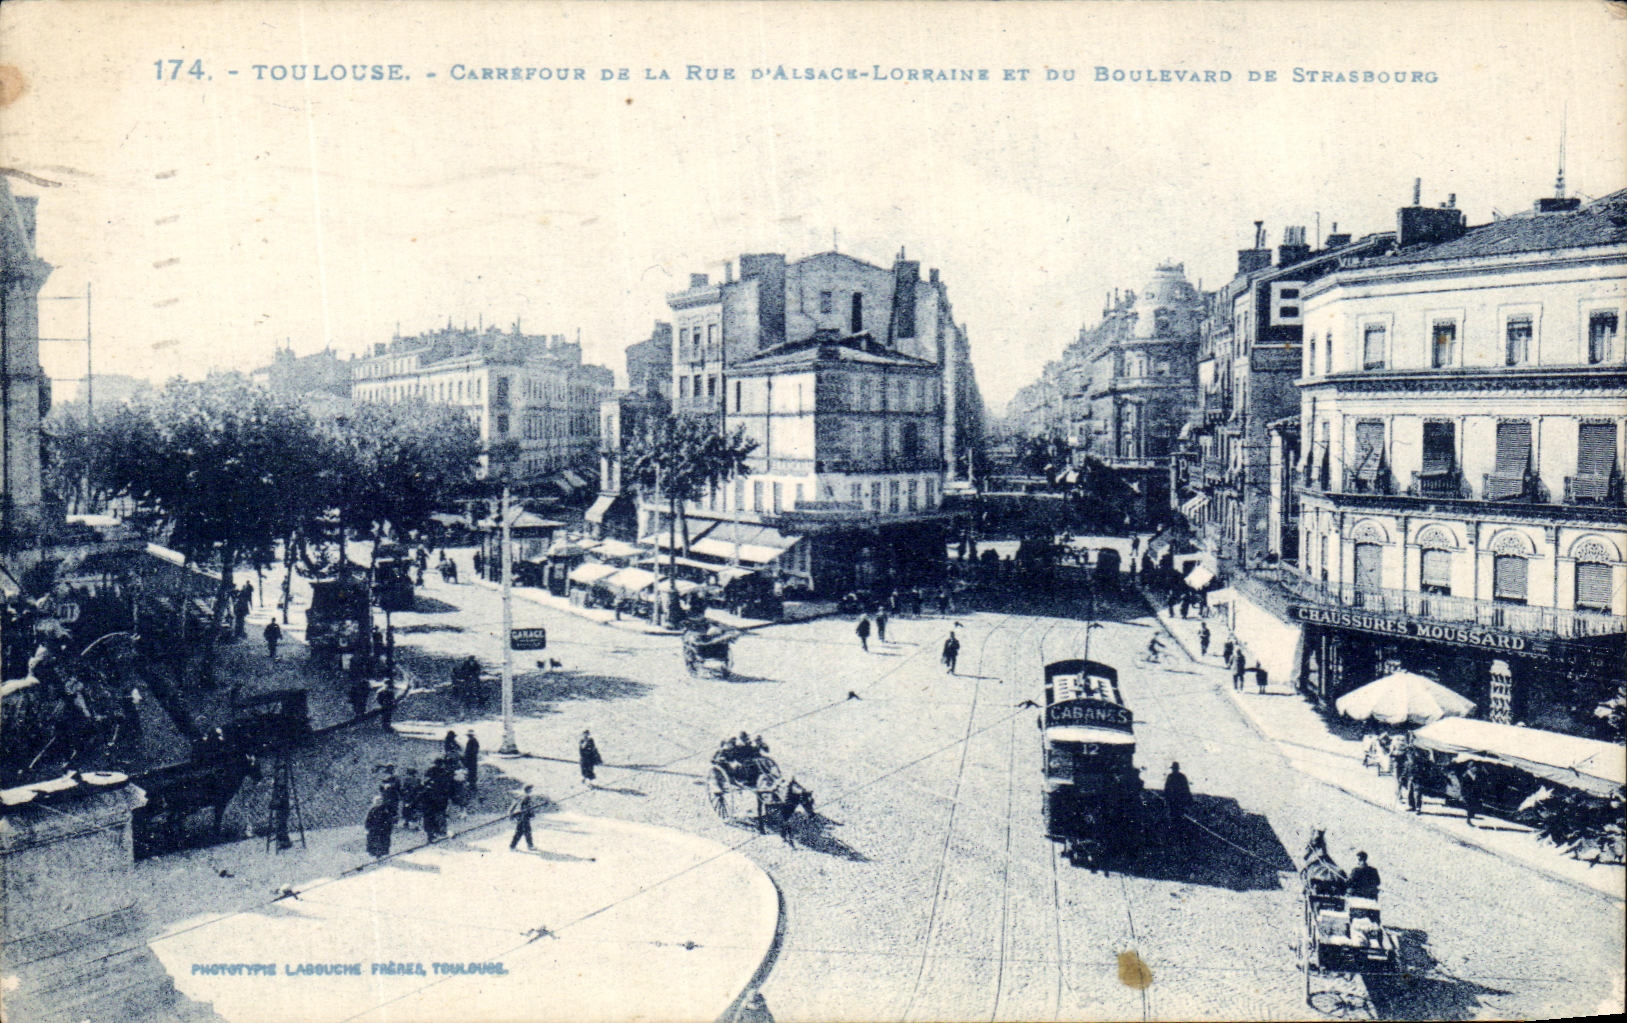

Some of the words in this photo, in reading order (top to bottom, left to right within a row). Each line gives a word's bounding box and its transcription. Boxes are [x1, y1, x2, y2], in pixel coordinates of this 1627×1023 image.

[1298, 608, 1408, 634] CHAUSSURES
[1417, 624, 1525, 650] MOUSSARD
[1050, 705, 1129, 724] CABANES
[1082, 744, 1100, 755] 12
